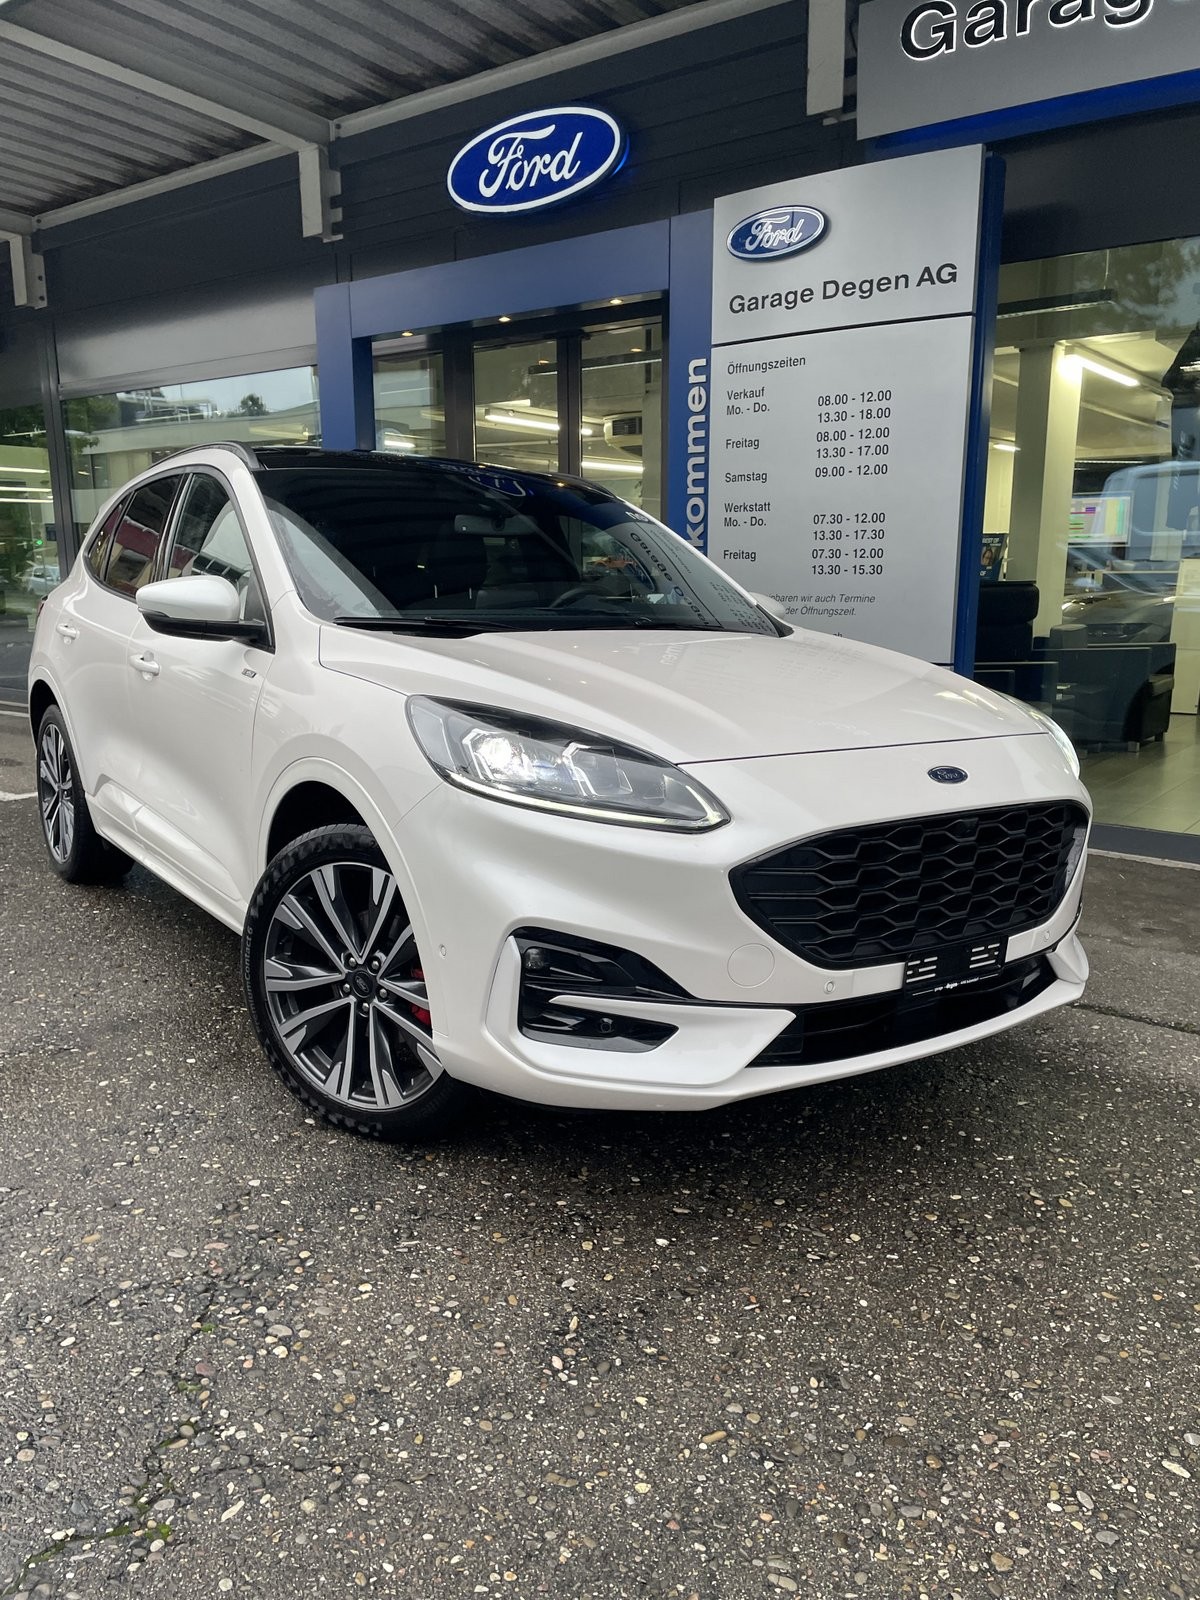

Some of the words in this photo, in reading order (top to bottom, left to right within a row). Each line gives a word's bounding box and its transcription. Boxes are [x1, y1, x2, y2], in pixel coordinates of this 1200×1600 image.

[479, 124, 583, 198] Ford
[745, 214, 805, 252] Ford
[729, 287, 815, 314] Garage
[822, 273, 910, 300] Degen
[915, 262, 958, 288] AG
[727, 356, 806, 375] Öffnungszeiten
[726, 386, 765, 401] Verkauf
[817, 393, 849, 407] 08.00
[860, 389, 892, 403] 12.00
[726, 404, 744, 416] Mo.
[753, 401, 770, 413] Do.
[817, 410, 848, 424] 13.30
[859, 406, 891, 420] 18.00
[816, 429, 847, 443] 08.00
[858, 426, 890, 440] 12.00
[725, 437, 760, 450] Freitag
[816, 446, 846, 459] 13.30
[857, 443, 889, 457] 17.00
[686, 357, 707, 552] kommen
[724, 471, 768, 484] Samstag
[814, 465, 846, 478] 09.00
[856, 463, 888, 476] 12.00
[724, 501, 771, 513] Werkstatt
[723, 516, 741, 528] Mo.
[749, 516, 767, 527] Do.
[813, 513, 843, 525] 07.30
[854, 512, 886, 524] 12.00
[813, 529, 843, 541] 13.30
[853, 528, 885, 540] 17.30
[723, 549, 757, 563] Freitag
[811, 548, 842, 560] 07.30
[853, 547, 884, 559] 12.00
[811, 564, 841, 576] 13.30
[852, 564, 883, 576] 15.30
[801, 594, 813, 603] wir
[814, 593, 838, 603] auch
[839, 593, 876, 604] Termine
